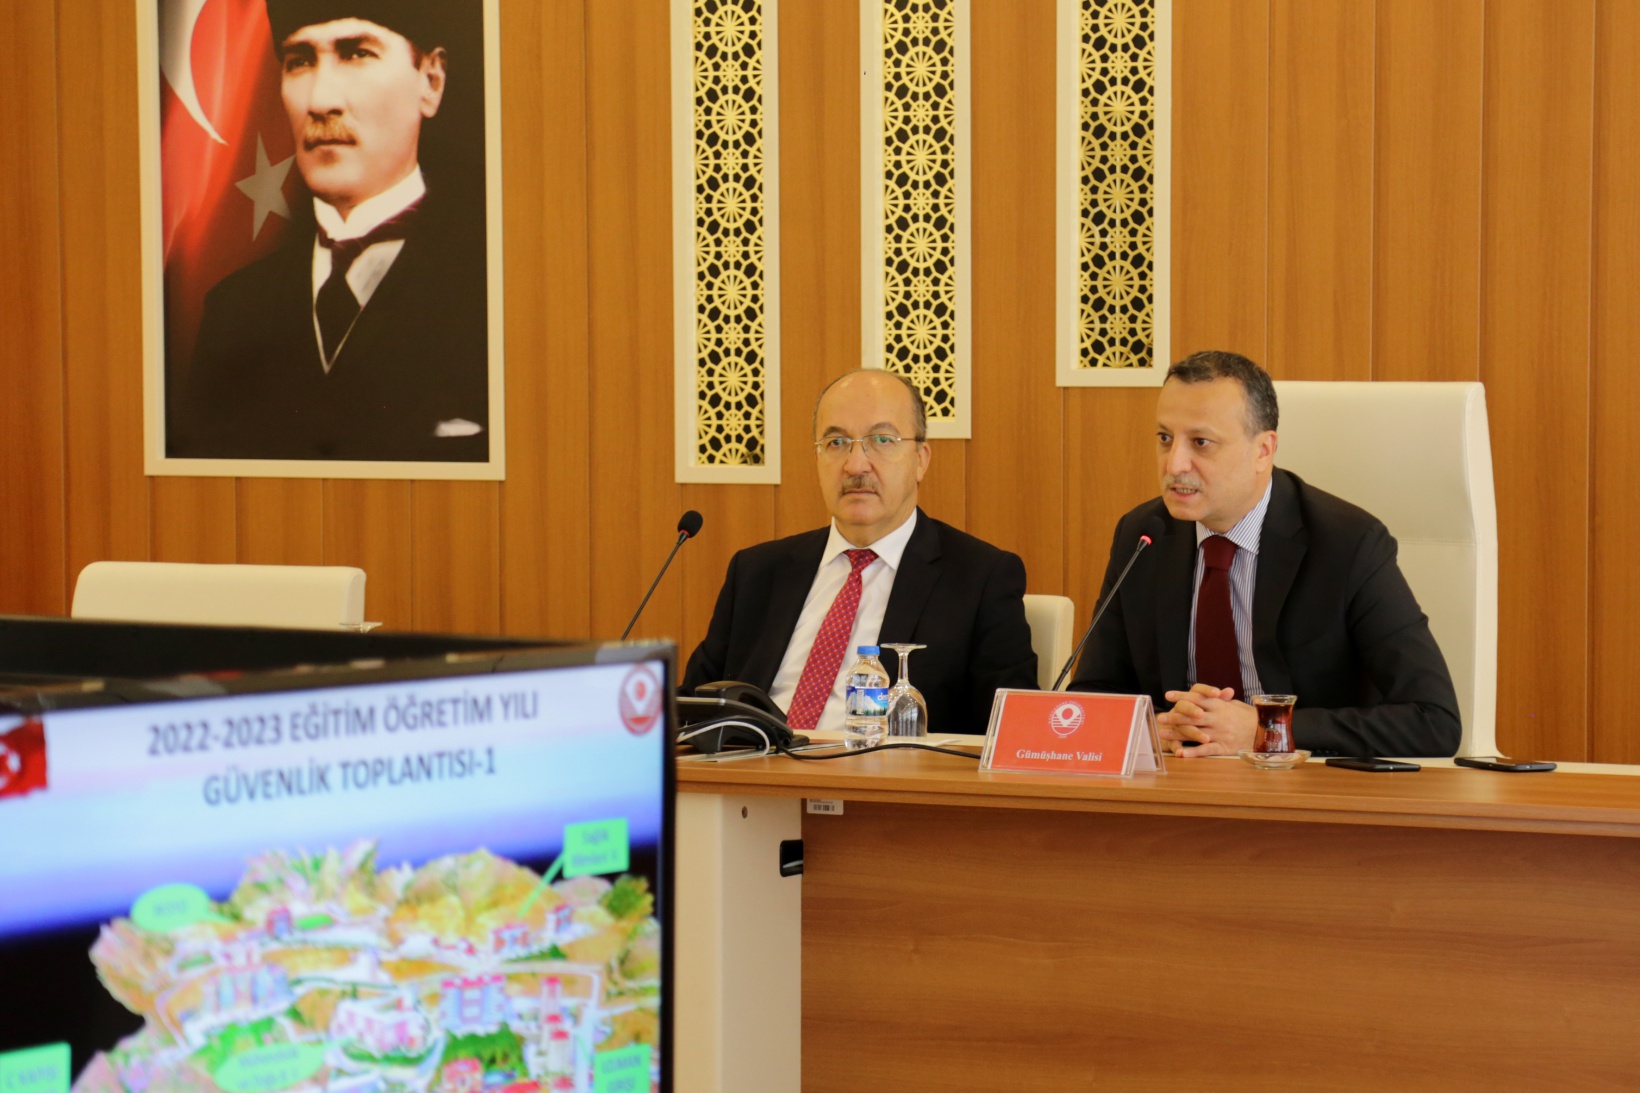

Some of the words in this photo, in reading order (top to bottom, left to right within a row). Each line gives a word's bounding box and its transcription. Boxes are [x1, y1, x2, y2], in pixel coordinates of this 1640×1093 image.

[147, 714, 282, 756] 2022-2023
[289, 700, 375, 742] EĞİTİM
[383, 691, 492, 733] ÖĞRETİM
[499, 690, 539, 721] YILI
[203, 757, 331, 806] GÜVENLİK
[339, 747, 495, 791] TOPLANTISI-1
[1015, 749, 1074, 761] Gümüşhane
[1076, 751, 1103, 762] Valisi
